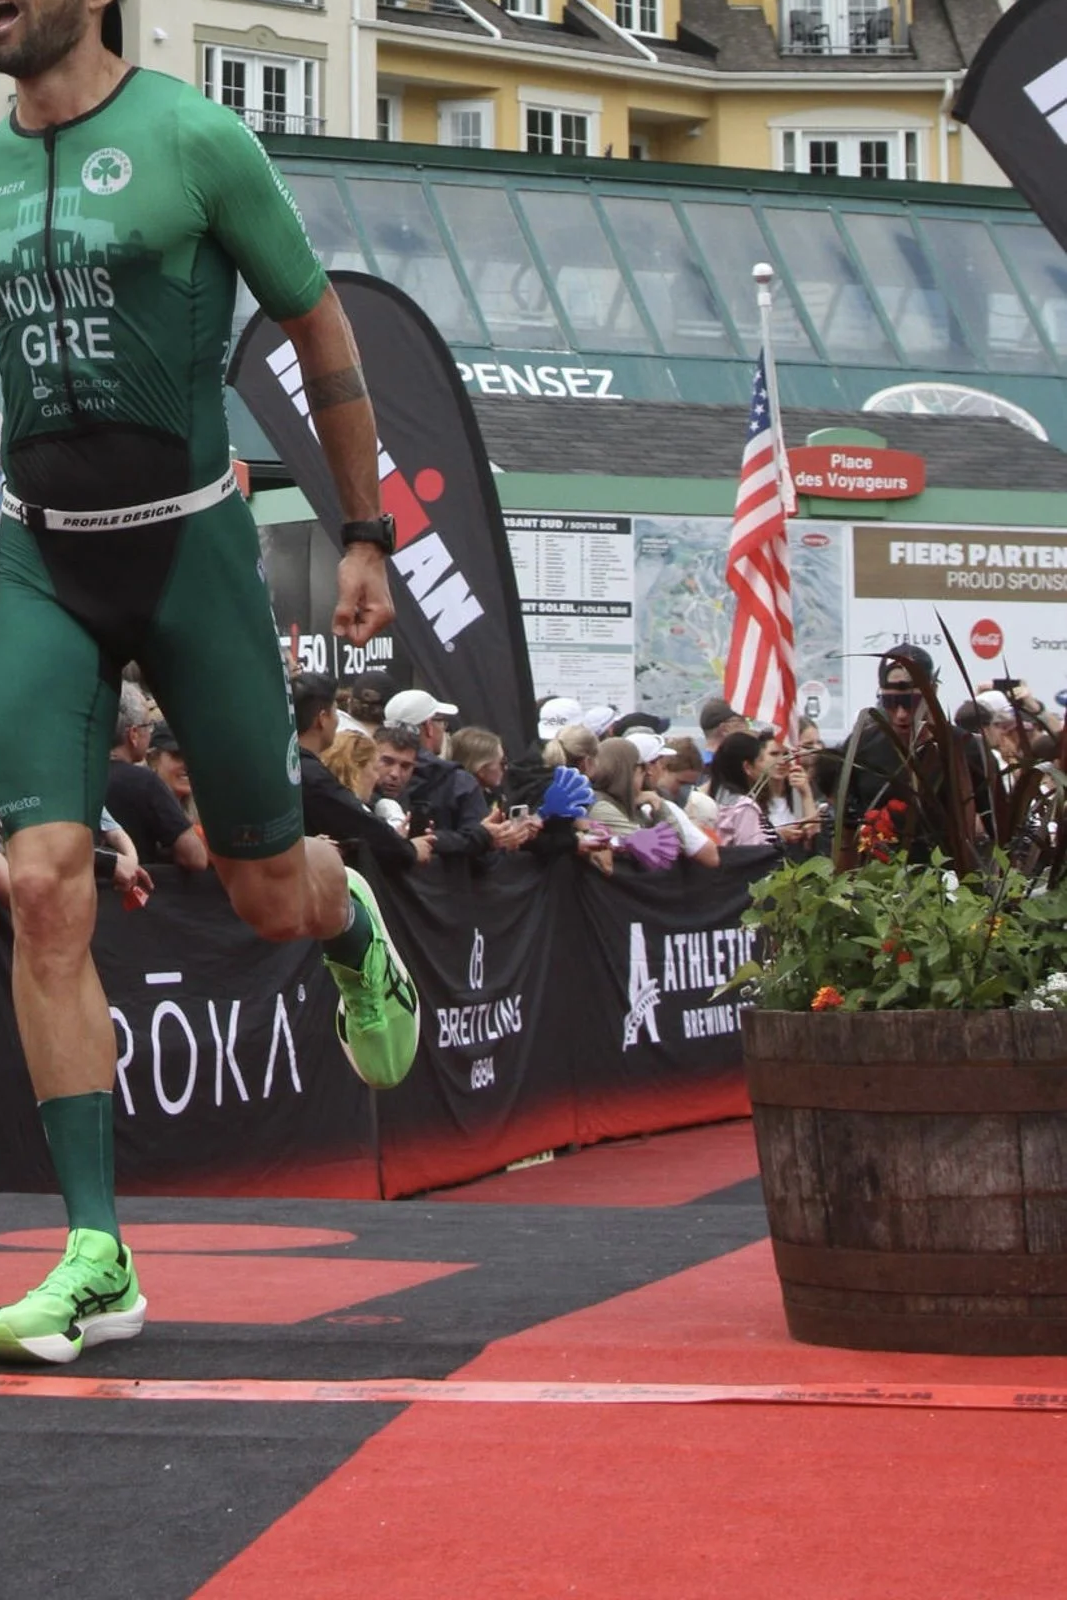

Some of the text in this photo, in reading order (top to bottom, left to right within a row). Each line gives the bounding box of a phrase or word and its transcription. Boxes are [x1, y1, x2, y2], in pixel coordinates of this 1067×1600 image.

[22, 317, 115, 366] GRE
[830, 453, 873, 470] Place
[795, 472, 908, 492] des Voyageurs
[63, 505, 174, 527] PROFILE DESIGN
[540, 519, 563, 529] SUD
[890, 541, 964, 567] FIERS
[947, 572, 1004, 589] PROUD
[893, 633, 943, 646] TELUS
[344, 644, 365, 674] 20
[437, 995, 522, 1048] BREITLING
[684, 1004, 733, 1039] BREWING
